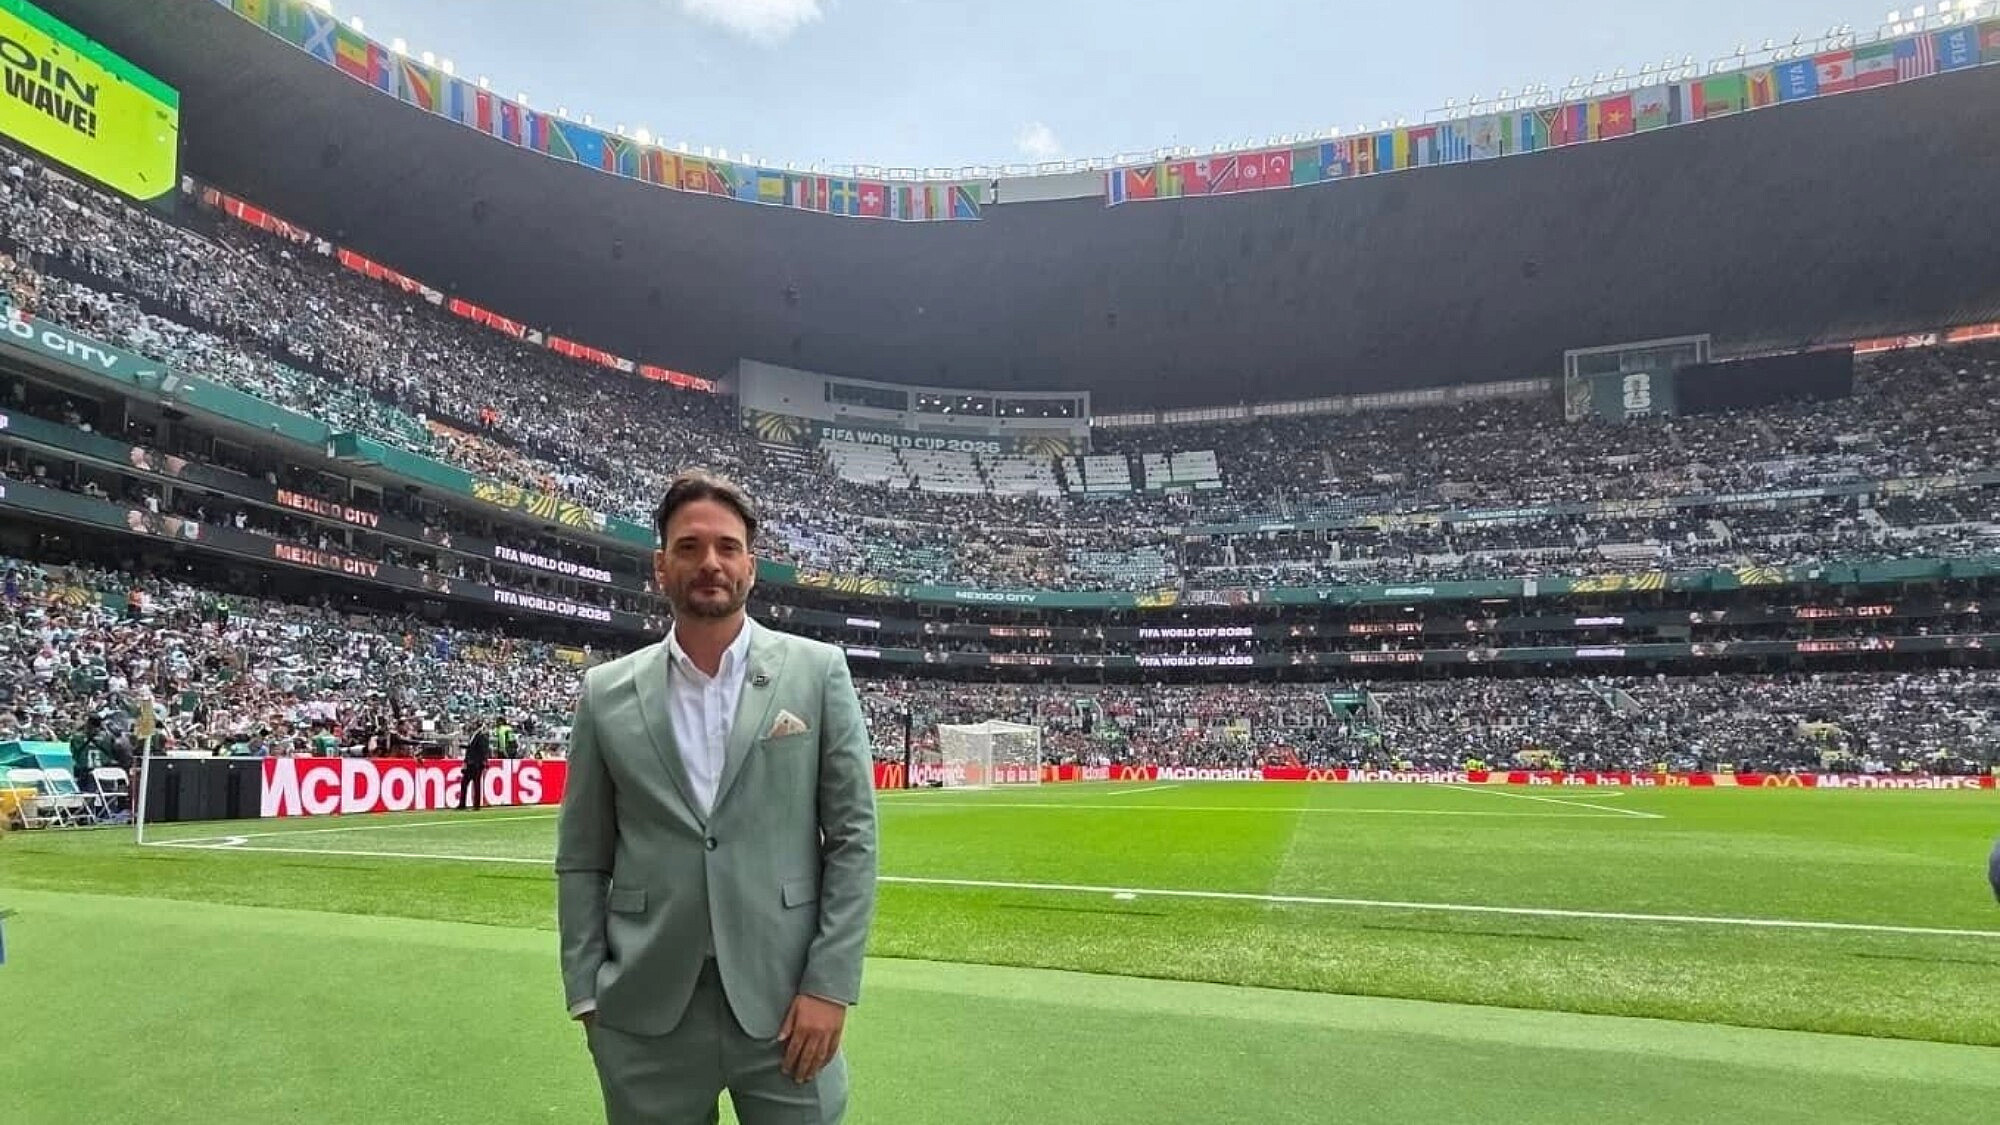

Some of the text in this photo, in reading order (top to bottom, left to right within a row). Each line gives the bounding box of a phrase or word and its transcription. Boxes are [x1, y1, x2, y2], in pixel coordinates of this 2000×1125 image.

[1952, 30, 1968, 64] FIFA
[1790, 63, 1807, 95] FIFA
[5, 65, 97, 139] WAVE!
[42, 331, 118, 368] CITY
[822, 427, 1001, 454] FIFA WORLD CUP 2026
[277, 488, 379, 529] MEXICO CITY
[275, 543, 379, 578] MEXICO CITY
[495, 545, 612, 583] FIFA WORLD CUP 2026
[494, 589, 612, 623] FIFA WORLD CUP 2026
[1139, 628, 1160, 639] FIFA
[1160, 628, 1197, 638] WORLD
[1197, 628, 1217, 638] CUP
[1161, 657, 1197, 666] WORLD
[1156, 766, 1264, 781] McDonald's
[1348, 769, 1469, 784] McDonald's
[1816, 774, 1981, 789] McDonald's
